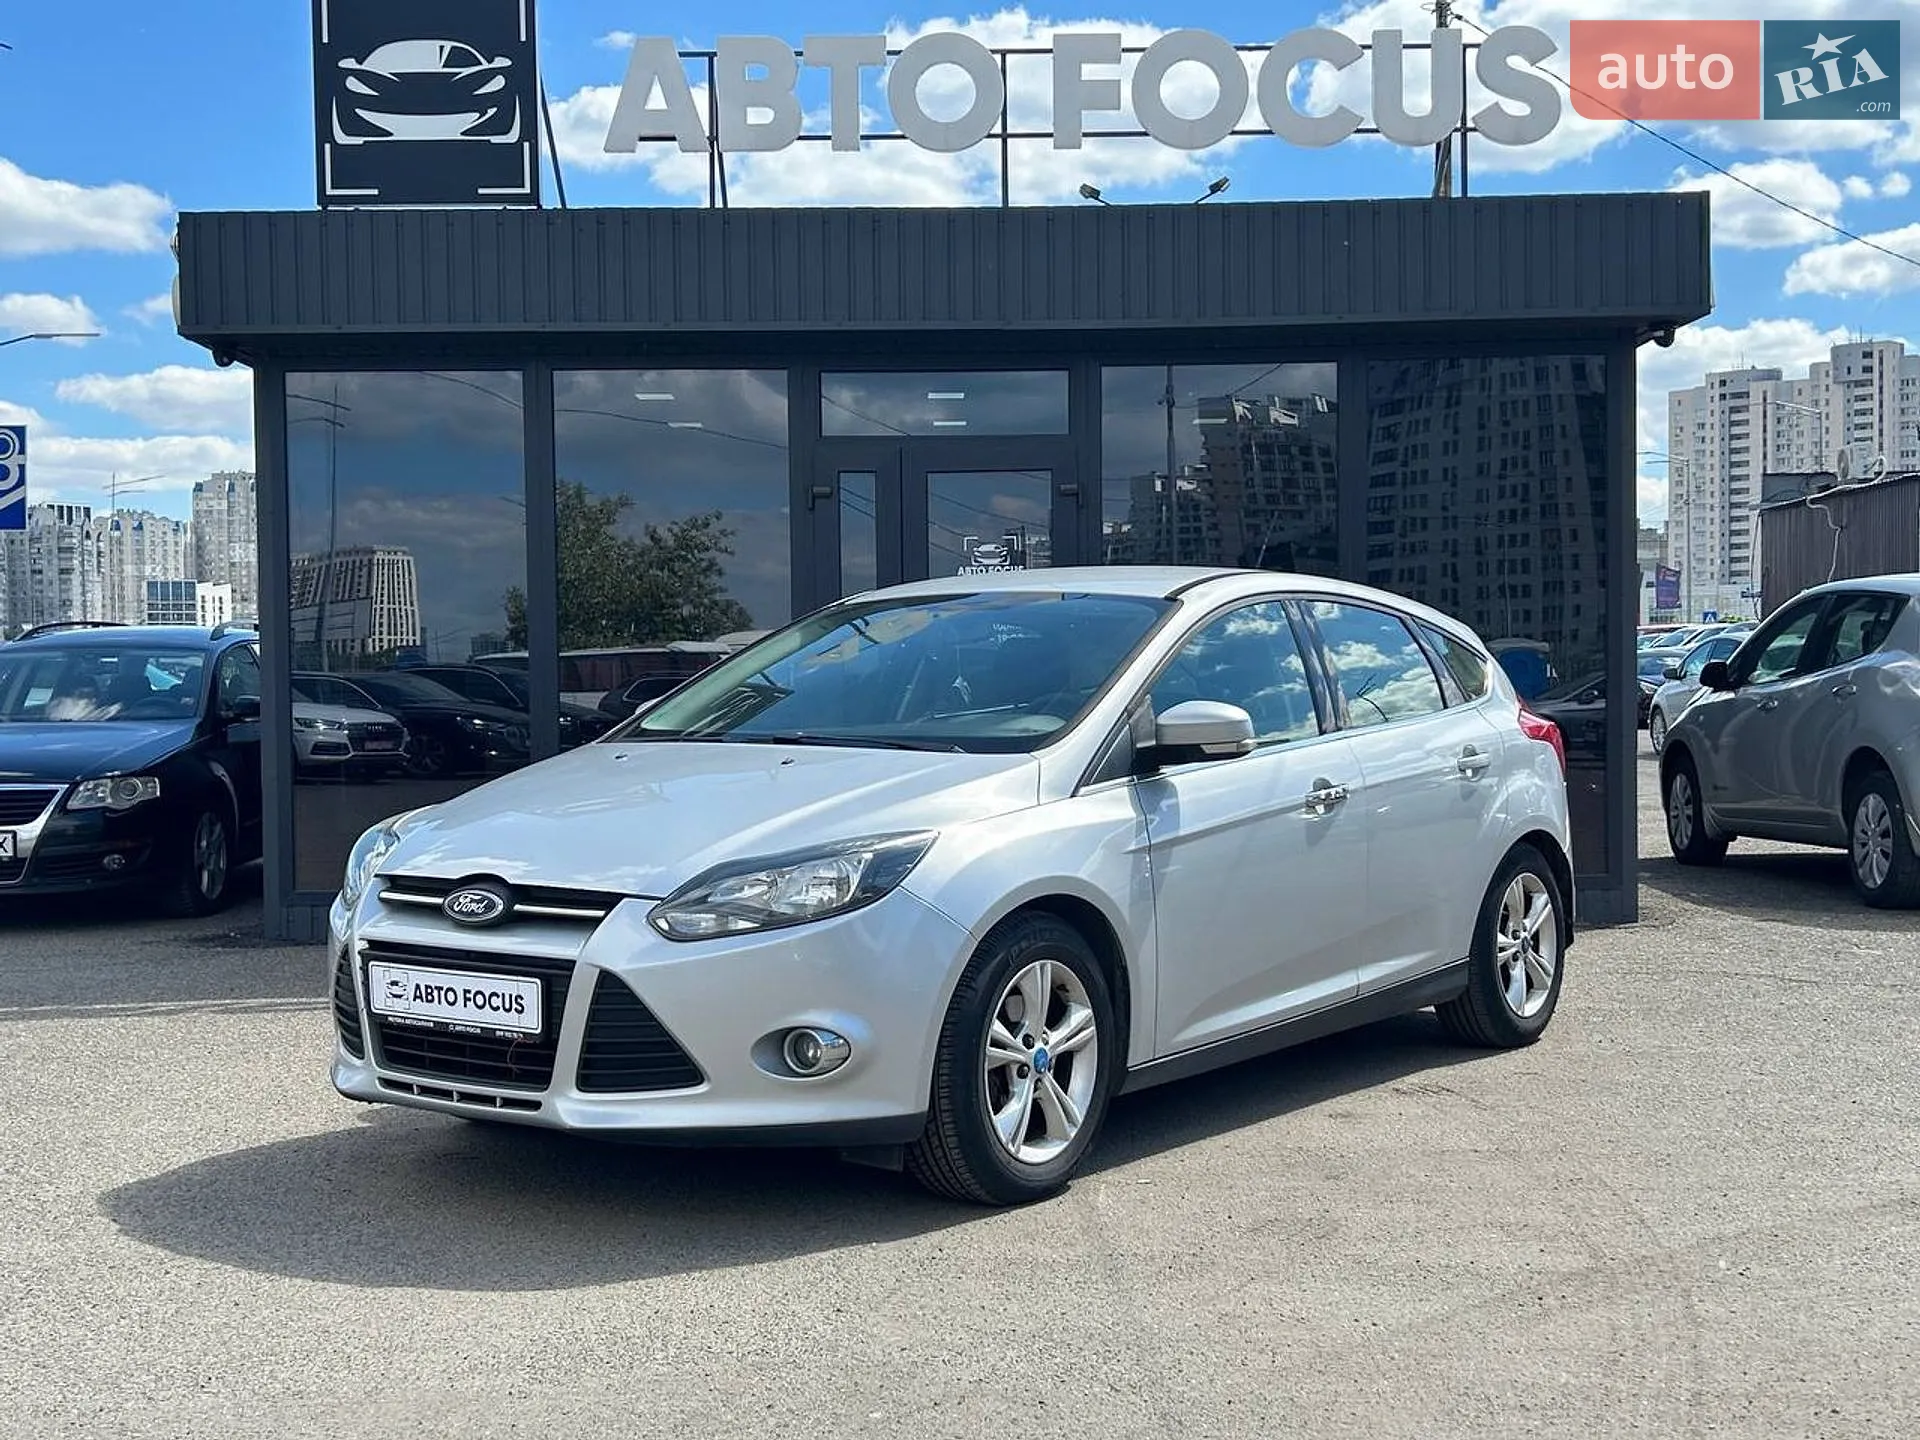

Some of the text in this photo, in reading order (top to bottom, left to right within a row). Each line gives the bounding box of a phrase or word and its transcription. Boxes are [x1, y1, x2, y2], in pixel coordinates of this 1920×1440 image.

[1053, 25, 1562, 150] FOCUS
[453, 894, 488, 913] Ford
[463, 988, 525, 1015] FOCUS
